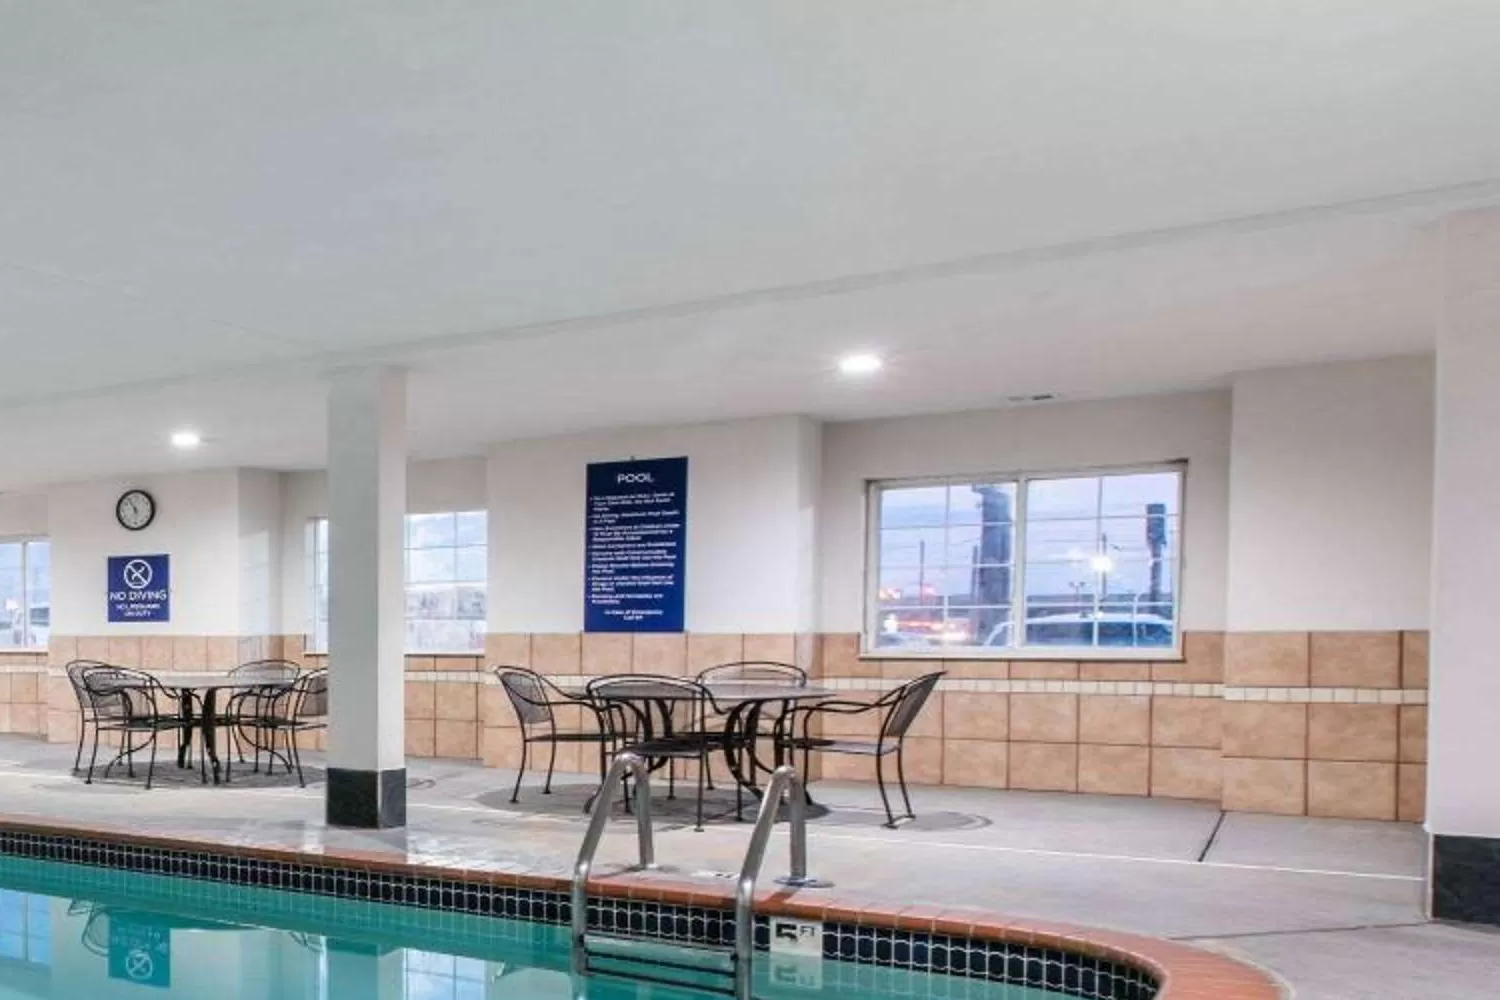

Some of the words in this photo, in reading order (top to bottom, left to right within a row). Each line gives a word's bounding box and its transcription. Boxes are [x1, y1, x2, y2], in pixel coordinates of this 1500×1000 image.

[617, 472, 654, 484] POOL
[109, 592, 127, 601] NO
[129, 590, 167, 601] DIVING
